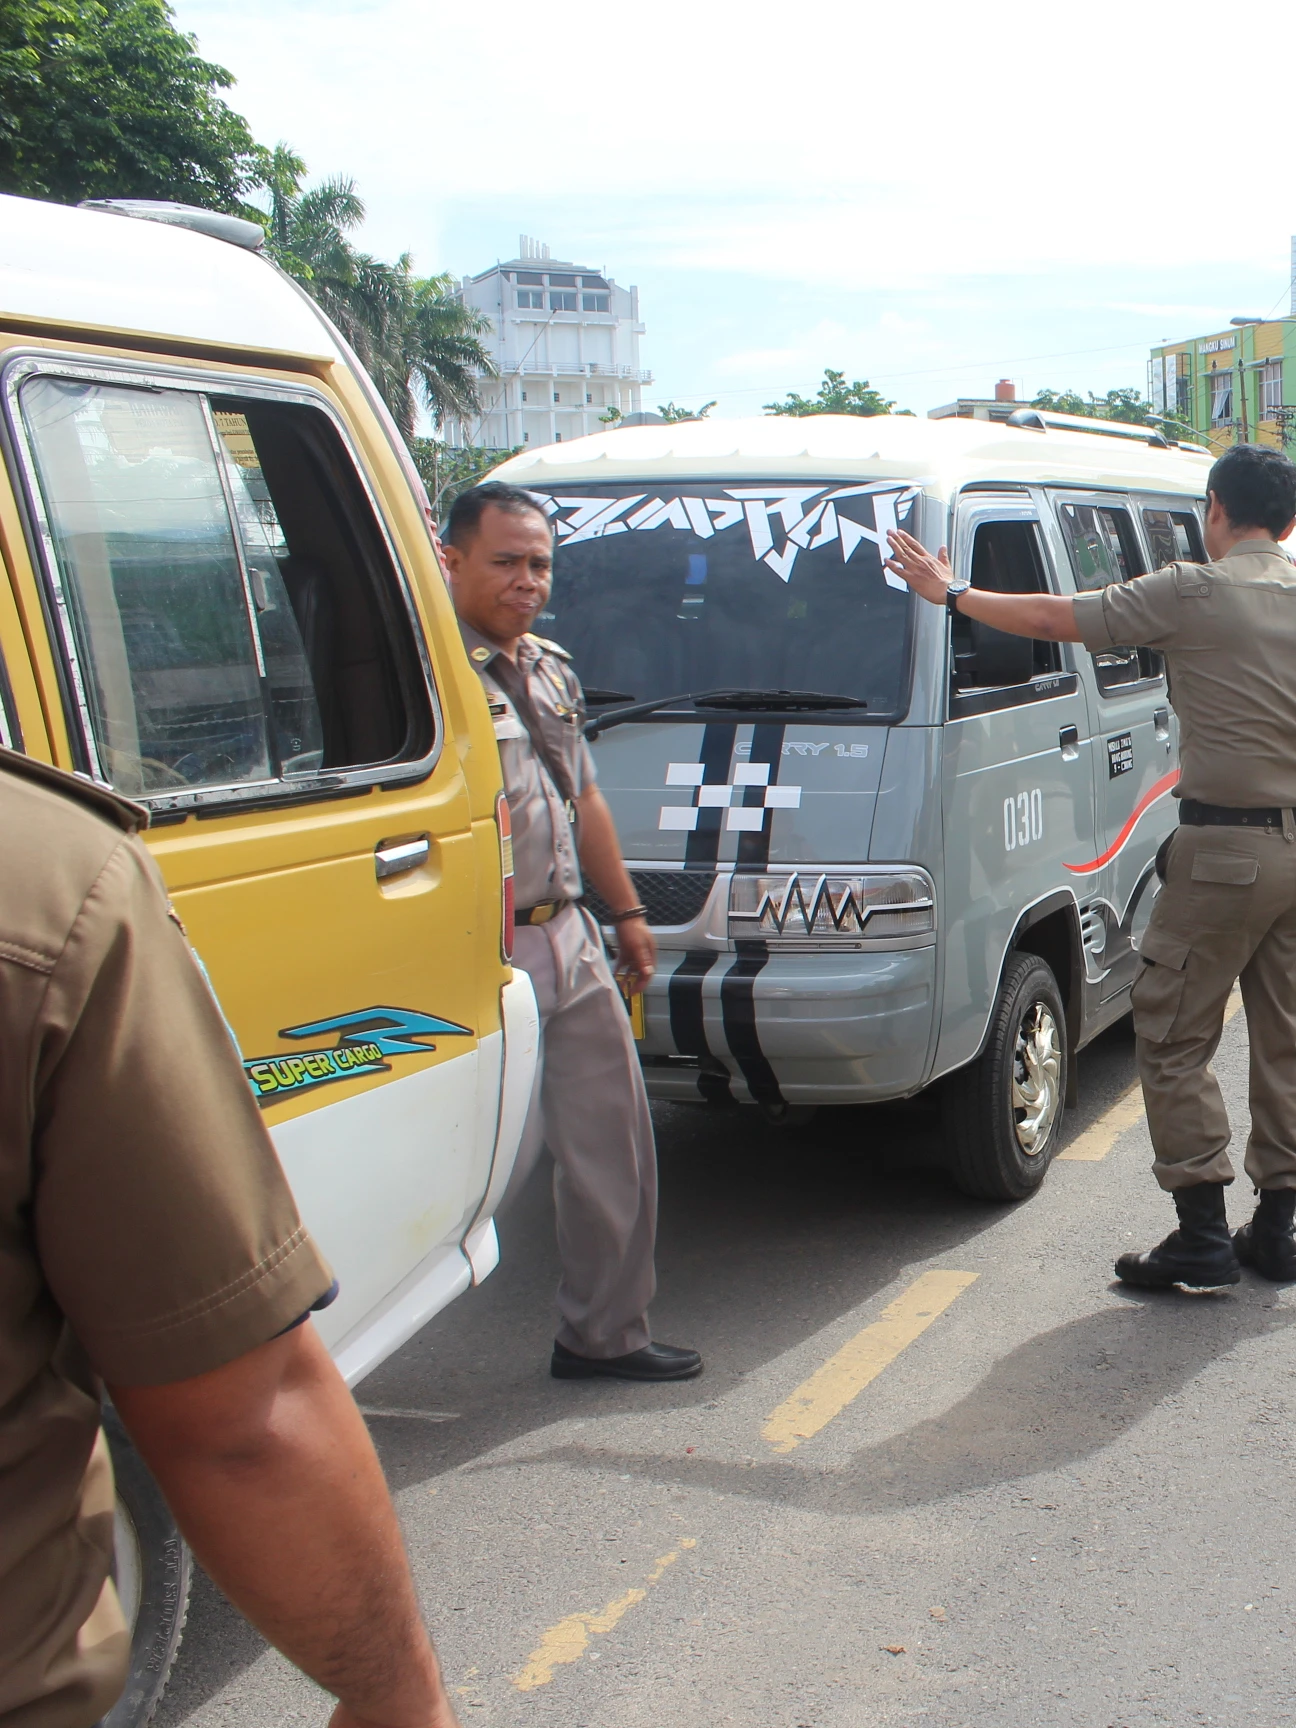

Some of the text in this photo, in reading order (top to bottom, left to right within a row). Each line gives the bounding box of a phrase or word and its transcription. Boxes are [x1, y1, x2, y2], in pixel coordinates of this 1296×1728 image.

[734, 742, 868, 758] CRRY 1.5
[1003, 788, 1042, 851] 030
[251, 1044, 383, 1092] SUPER CARGO
